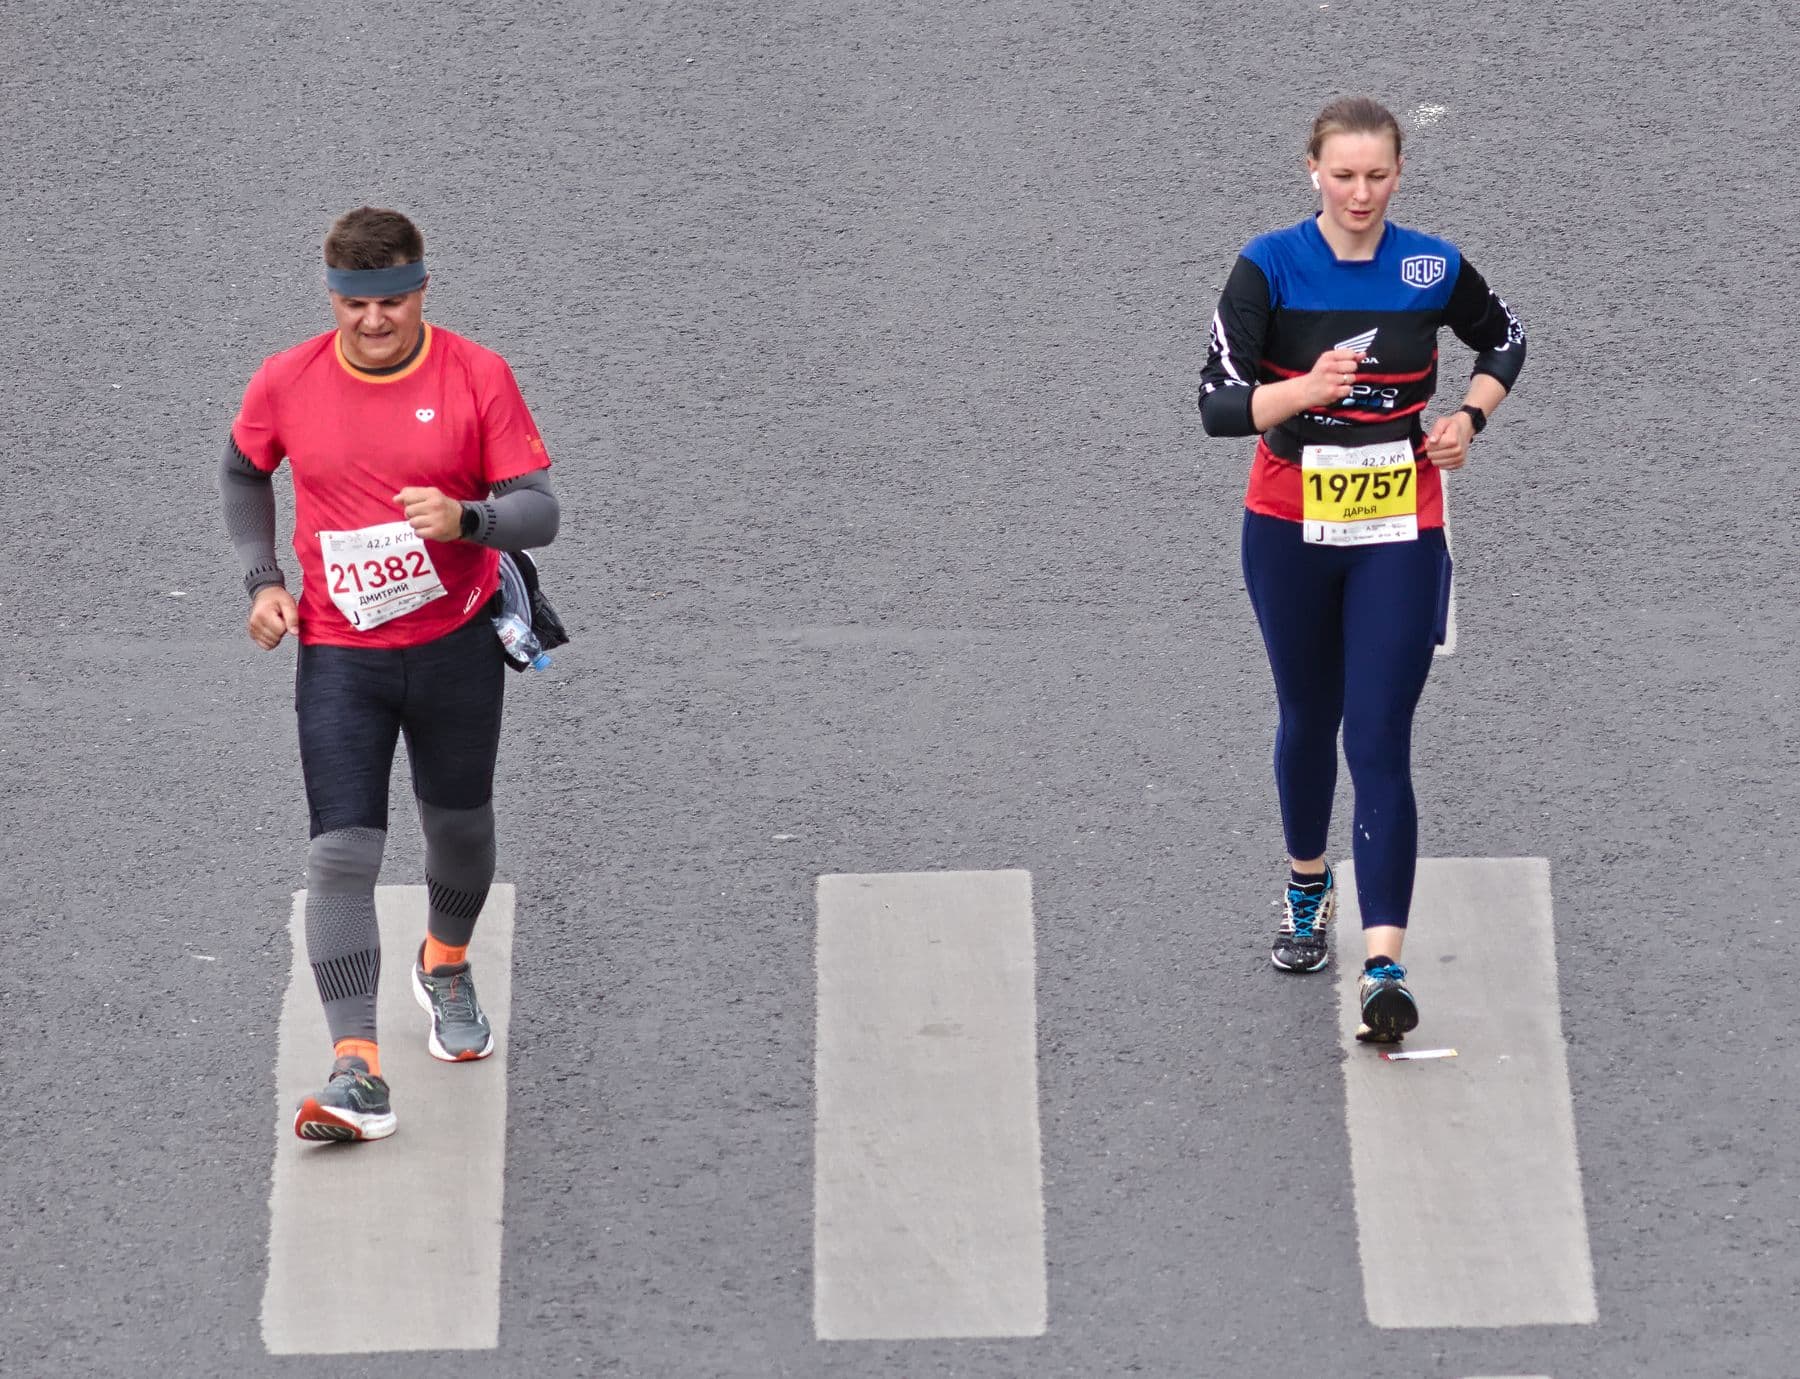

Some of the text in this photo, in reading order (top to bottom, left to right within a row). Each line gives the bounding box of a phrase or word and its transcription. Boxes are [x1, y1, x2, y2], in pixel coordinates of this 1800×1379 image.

[1407, 259, 1441, 283] DEUS
[1350, 385, 1399, 398] Pro
[1361, 456, 1386, 467] 42,2
[1309, 467, 1412, 503] 19757
[1343, 505, 1377, 518] ДАРЬЯ
[367, 536, 391, 549] 42,2
[330, 551, 431, 594] 21382
[359, 583, 409, 605] ДМИТРИЙ
